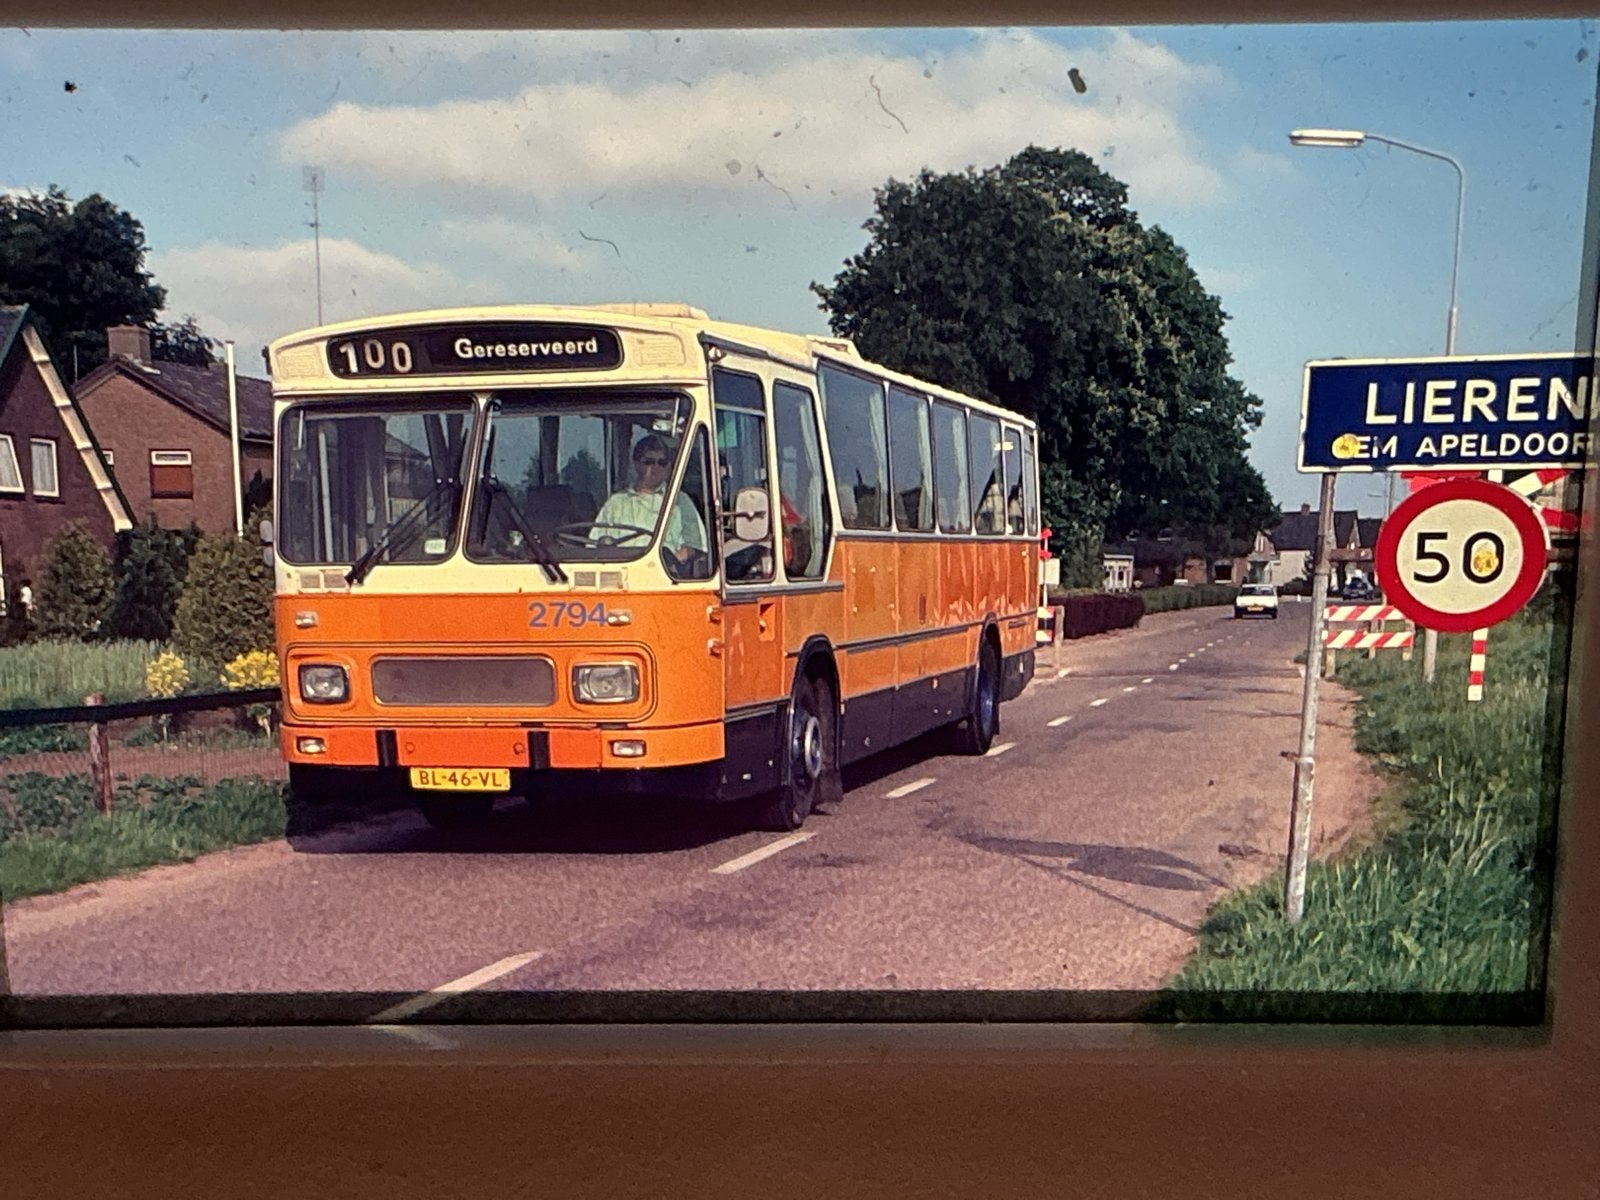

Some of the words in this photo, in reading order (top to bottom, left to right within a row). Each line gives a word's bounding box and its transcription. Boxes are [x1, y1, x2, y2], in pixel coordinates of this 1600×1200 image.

[340, 339, 413, 373] 100
[454, 337, 599, 359] Gereserveerd
[1365, 376, 1588, 424] LIEREN
[1413, 531, 1505, 583] 50
[528, 602, 607, 628] 2794
[419, 770, 503, 788] BL-46-VL
